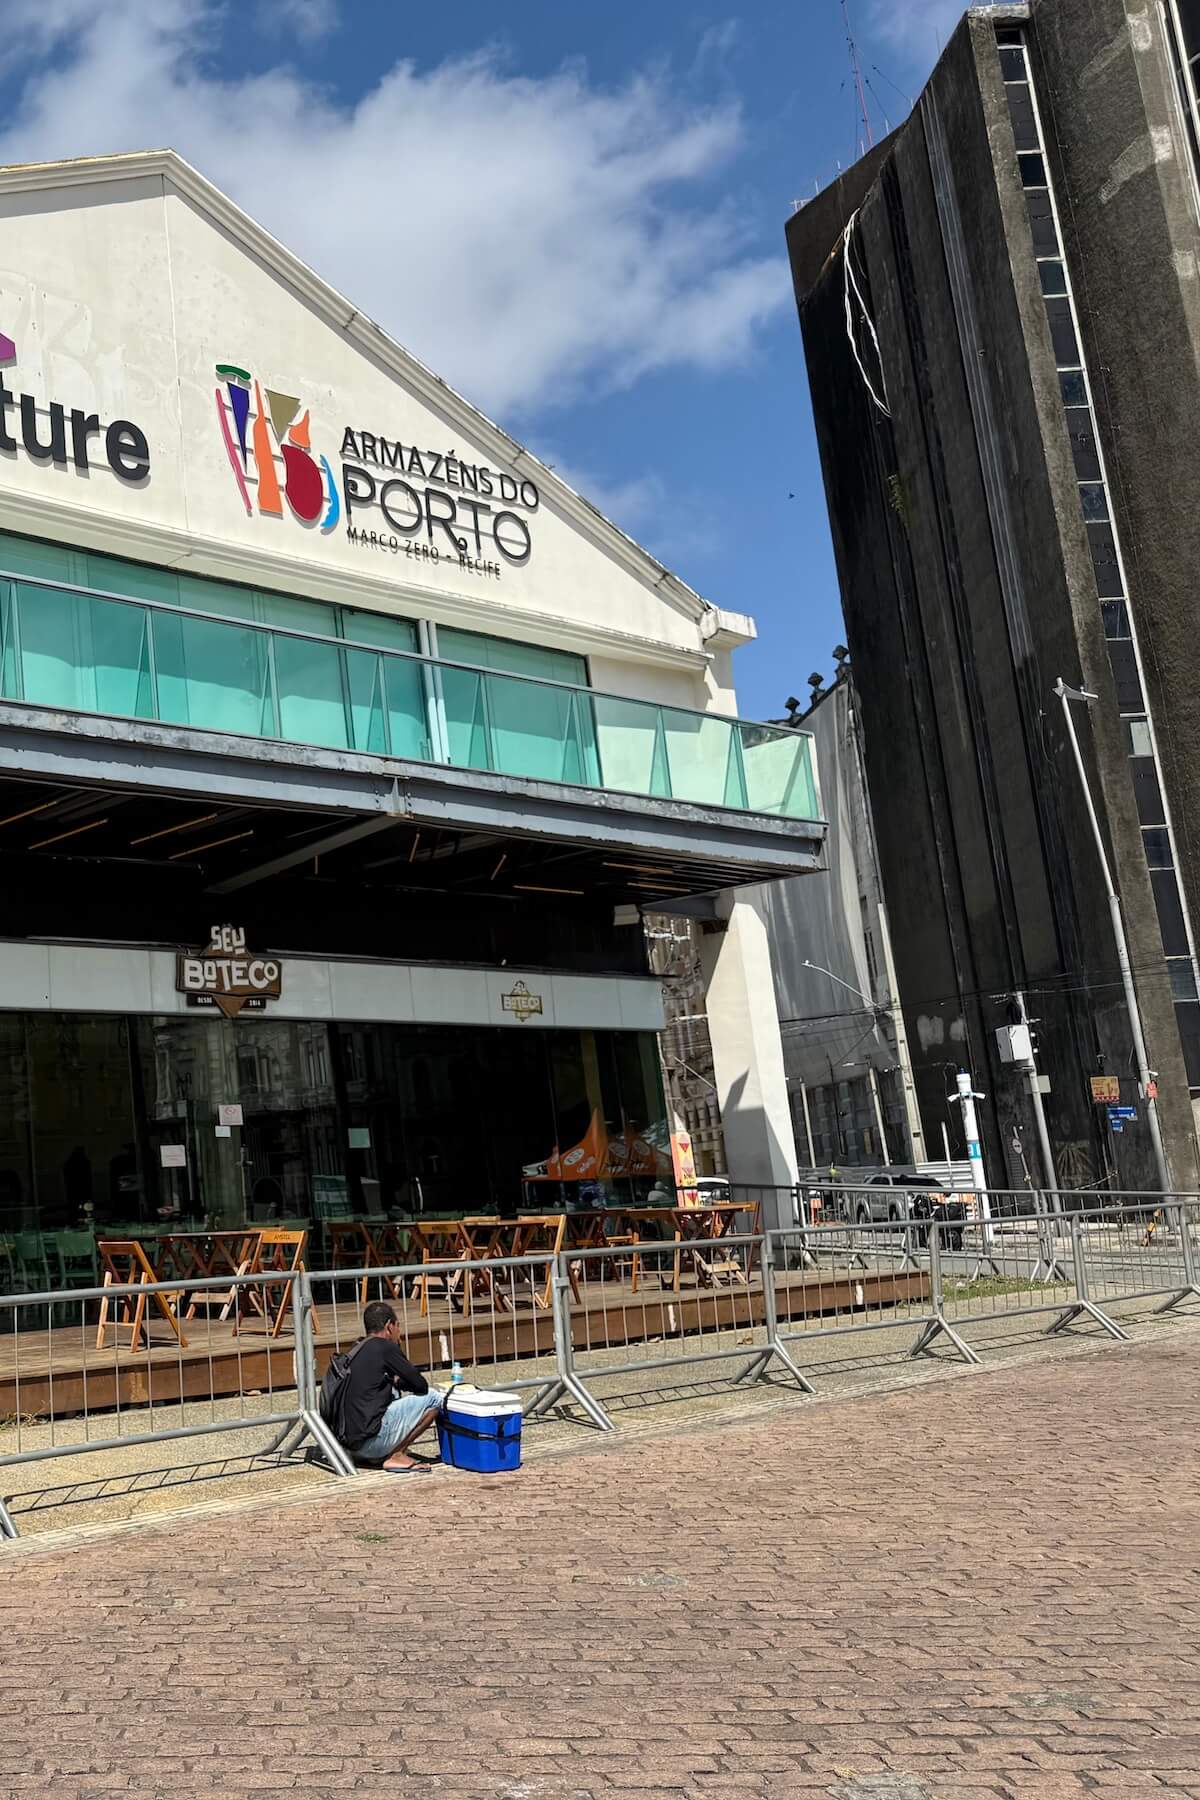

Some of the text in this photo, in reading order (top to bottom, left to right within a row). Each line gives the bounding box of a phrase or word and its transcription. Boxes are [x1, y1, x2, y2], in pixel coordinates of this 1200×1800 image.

[341, 426, 540, 508] ARMAZÉNS DO
[343, 464, 531, 560] PORTO
[346, 525, 399, 551] MARCO
[405, 539, 440, 561] ZERO
[458, 553, 501, 577] RECIFE
[211, 925, 246, 955] SEU
